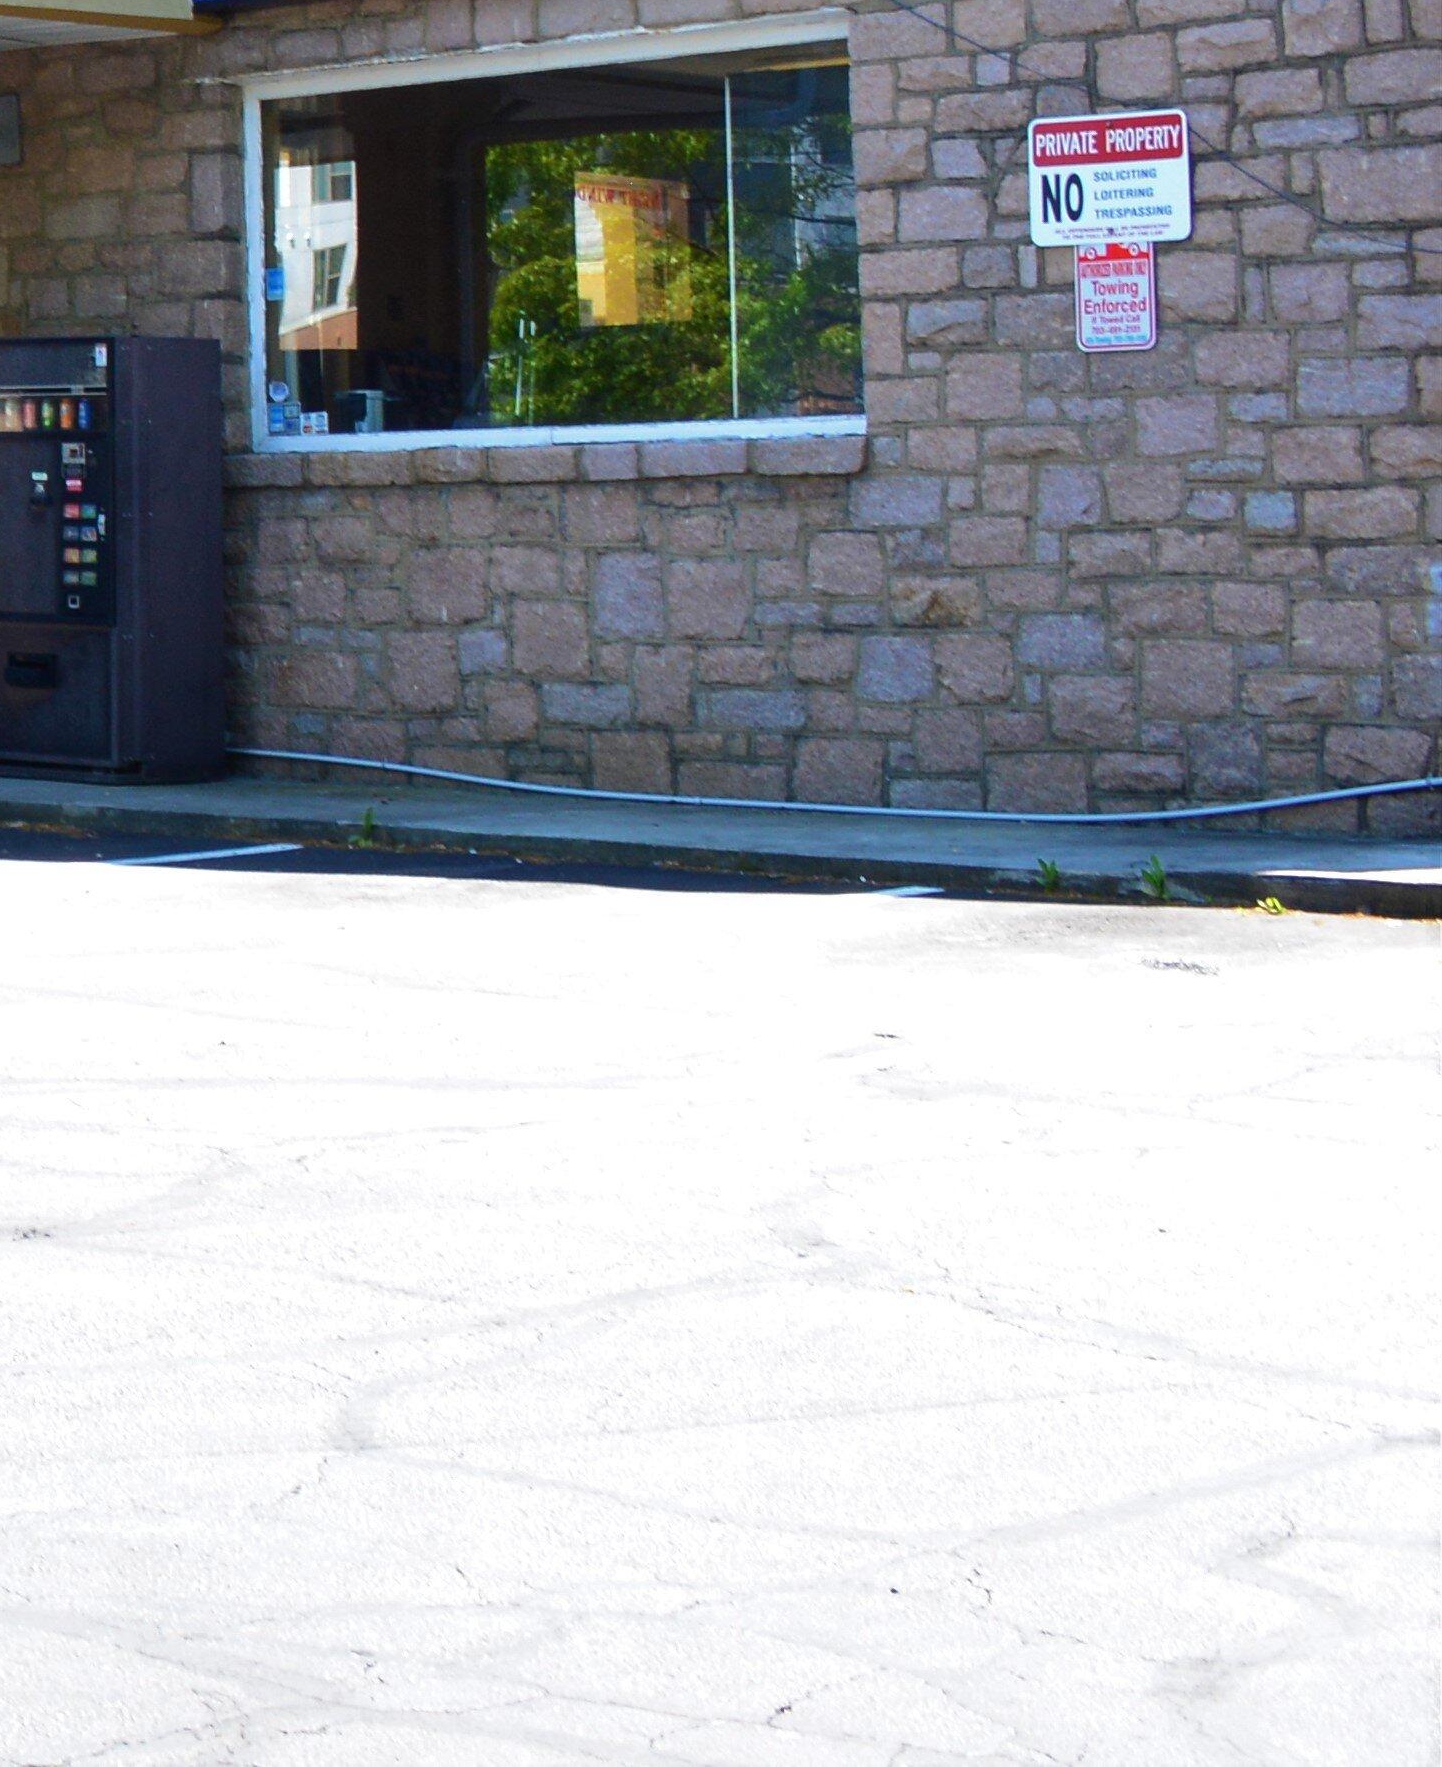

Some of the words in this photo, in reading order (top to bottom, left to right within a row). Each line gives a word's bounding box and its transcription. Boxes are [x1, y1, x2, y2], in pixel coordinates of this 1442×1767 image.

[1035, 130, 1099, 157] PRIVATE
[1105, 124, 1181, 153] PROPERTY
[1093, 167, 1158, 183] SOLICITING
[1041, 173, 1084, 224] NO
[1094, 187, 1155, 201] LOITERING
[1094, 204, 1173, 220] TRESPASSING
[1091, 279, 1139, 298] Towing
[1084, 297, 1147, 314] Enforced
